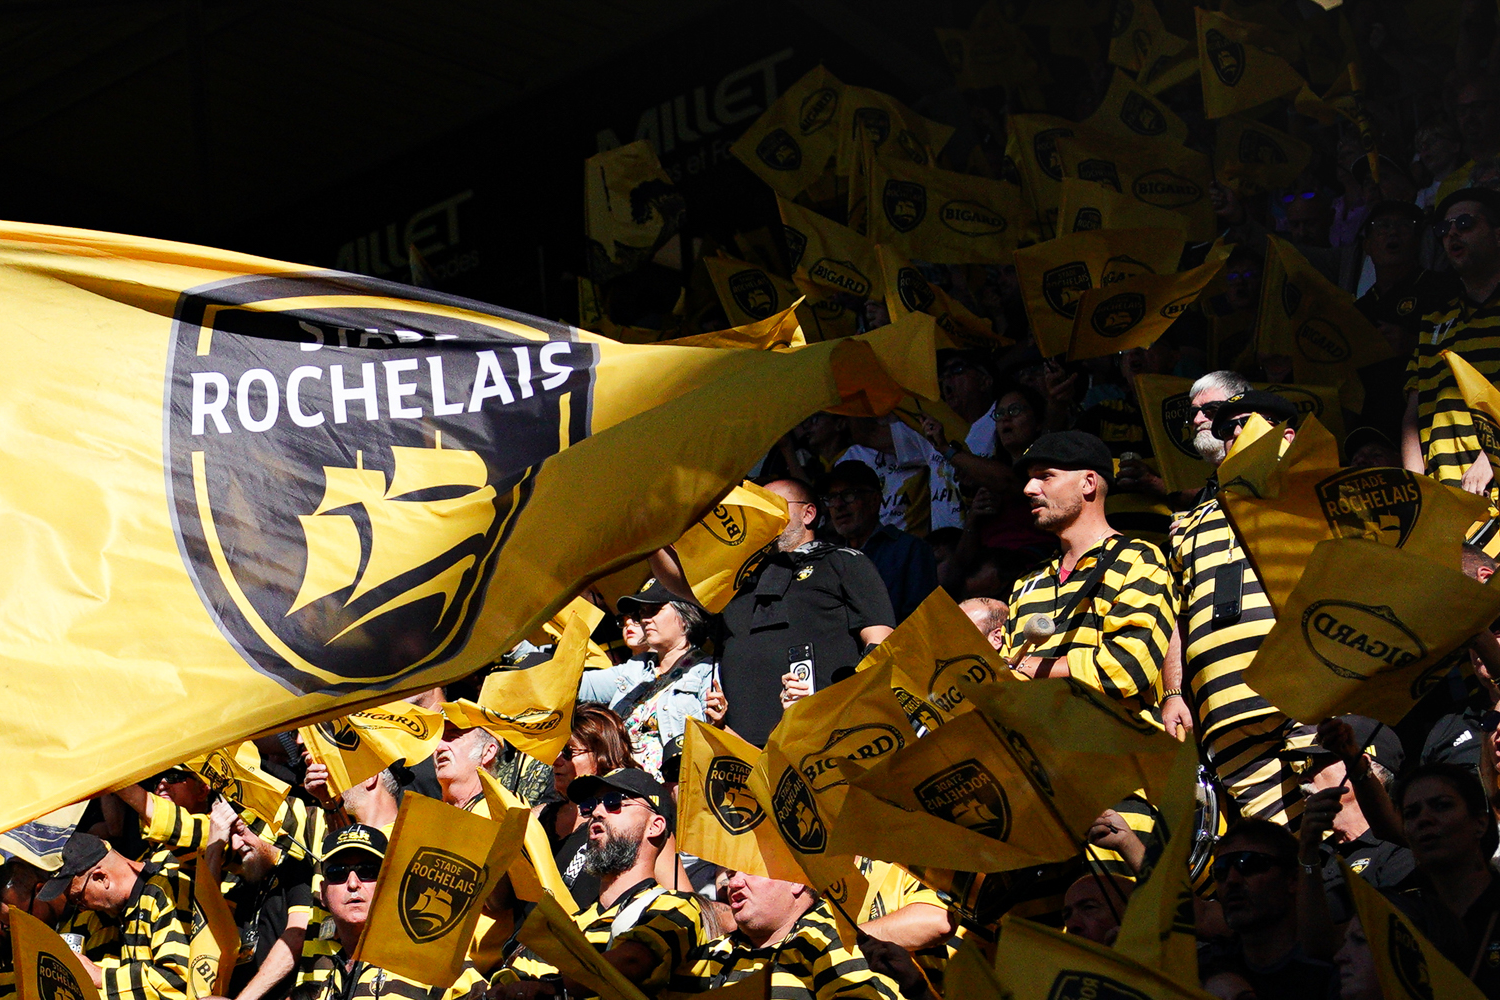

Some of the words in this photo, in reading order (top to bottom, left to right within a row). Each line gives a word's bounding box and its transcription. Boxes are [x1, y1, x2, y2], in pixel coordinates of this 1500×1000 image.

[1138, 180, 1198, 196] BIGARD
[943, 207, 1004, 227] BIGARD
[815, 264, 866, 298] BIGARD
[1300, 325, 1346, 358] BIGARD
[190, 341, 574, 437] ROCHELAIS
[1347, 473, 1388, 491] STADE
[1325, 484, 1420, 518] ROCHELAIS
[712, 501, 742, 539] BIG
[711, 769, 748, 783] ROCHE
[729, 763, 752, 773] STAD
[411, 862, 477, 896] ROCHELAIS
[434, 858, 463, 876] STADE
